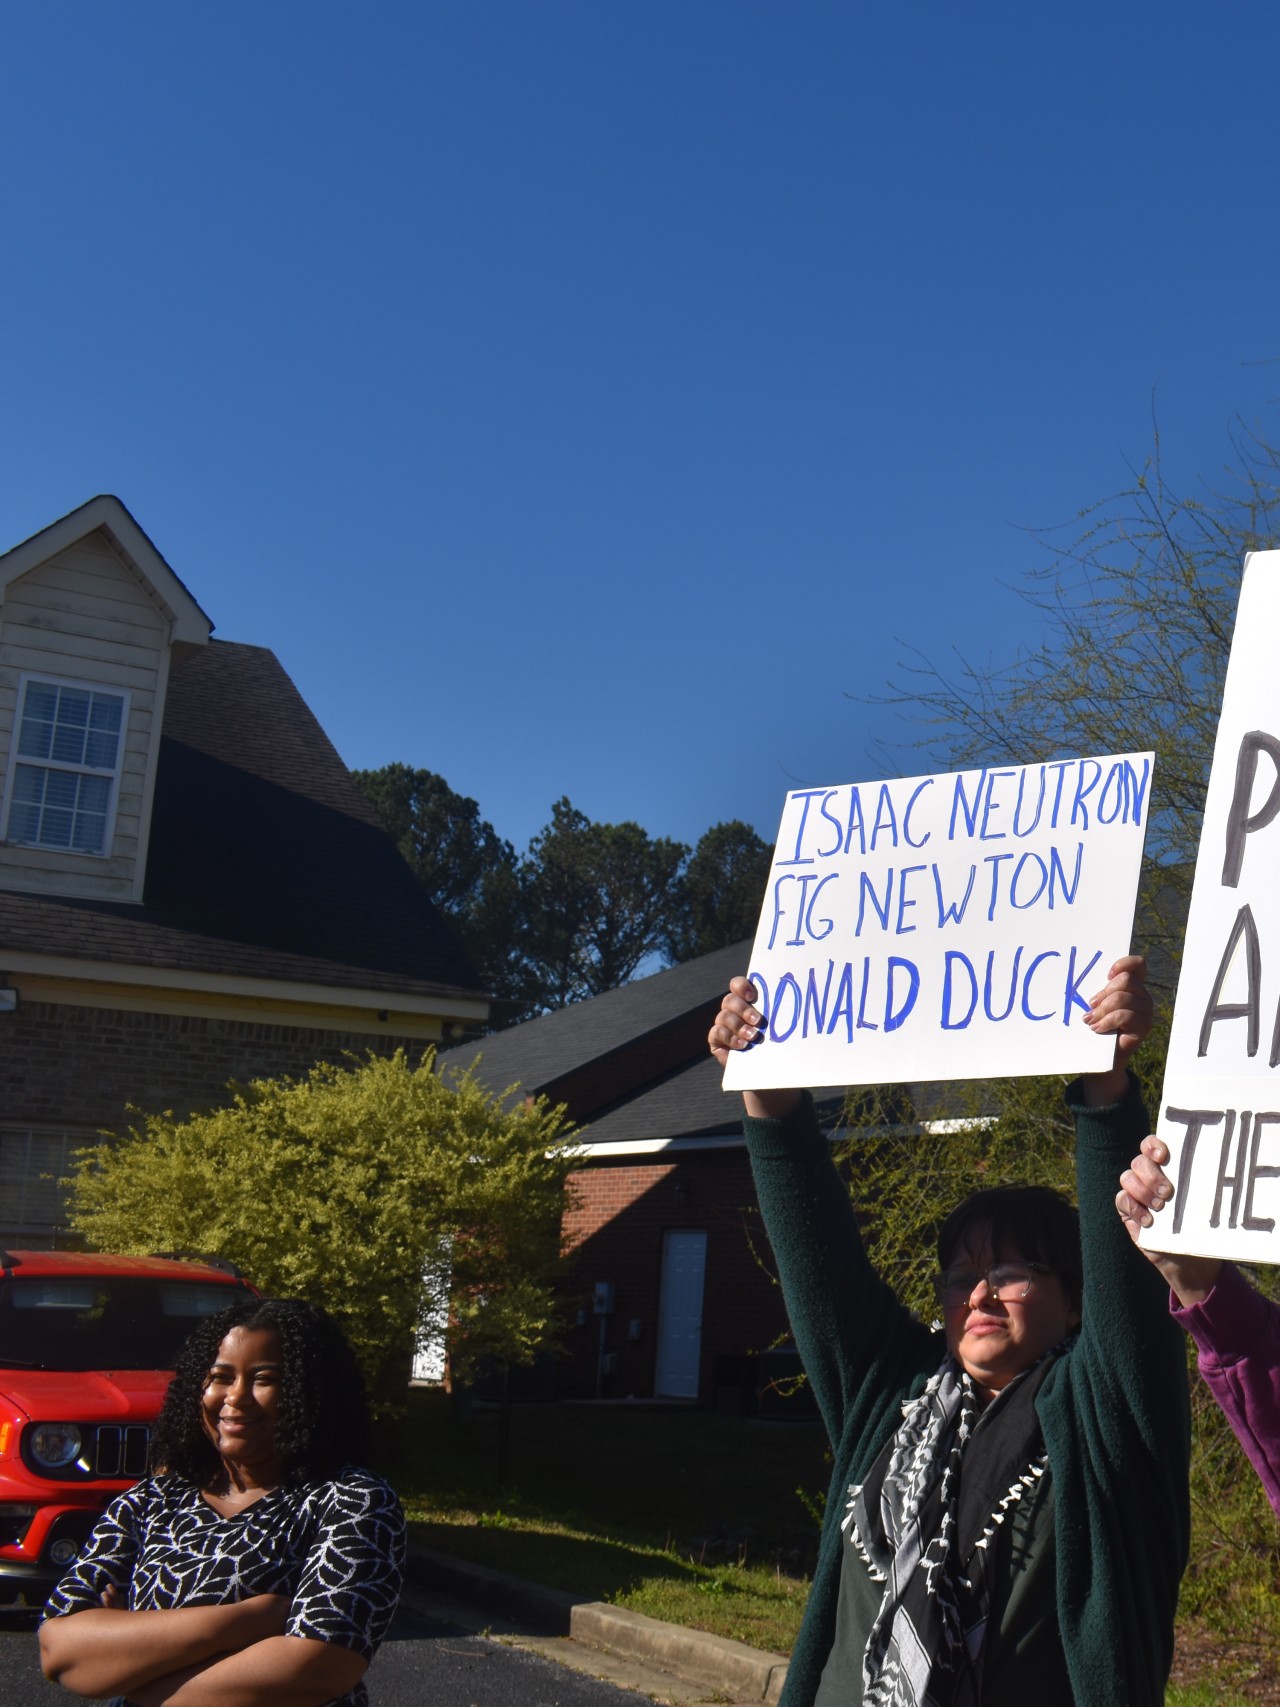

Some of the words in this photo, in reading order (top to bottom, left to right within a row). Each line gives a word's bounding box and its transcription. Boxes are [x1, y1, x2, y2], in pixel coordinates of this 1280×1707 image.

[776, 779, 934, 865] ISAAC
[949, 758, 1150, 841] NEUTRON
[768, 873, 839, 950] FIG
[855, 842, 1084, 937] NEWTON
[940, 945, 1103, 1031] DUCK
